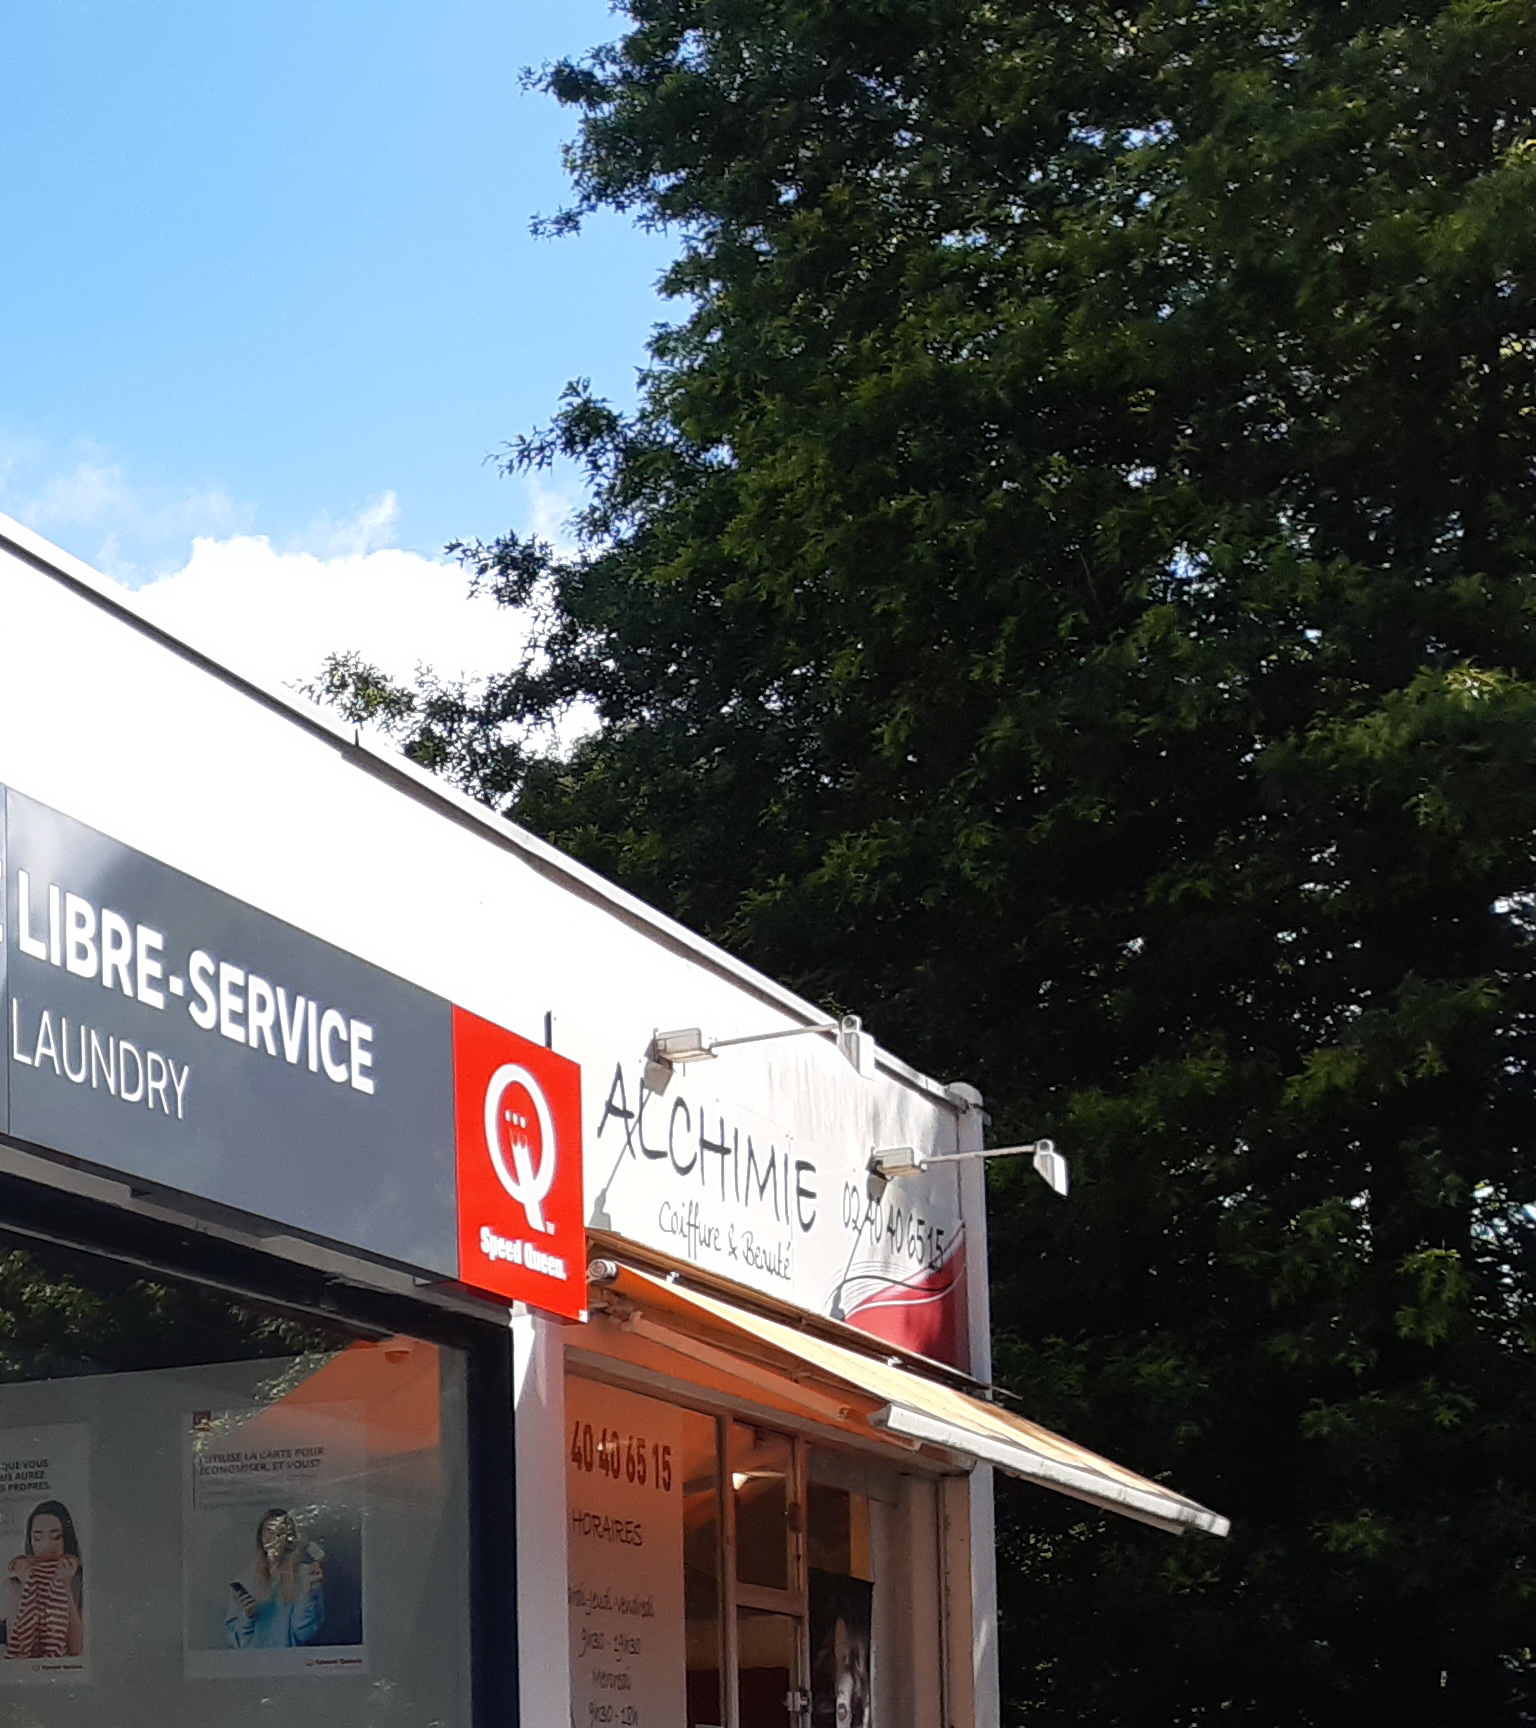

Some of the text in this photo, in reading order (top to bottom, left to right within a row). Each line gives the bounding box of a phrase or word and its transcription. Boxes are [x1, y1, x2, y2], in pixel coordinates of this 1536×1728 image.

[17, 868, 375, 1095] LIBRE-SERVICE
[12, 997, 190, 1120] LAUNDRY
[596, 1061, 817, 1234] ALCHIMIE
[480, 1225, 566, 1281] Speed Queen
[658, 1199, 722, 1261] Coiffure
[741, 1231, 792, 1281] Beauté
[887, 1204, 903, 1255] 40
[907, 1213, 925, 1264] 65
[23, 1459, 49, 1469] VOUS
[244, 1451, 257, 1461] LA
[260, 1449, 292, 1460] CARTE
[295, 1447, 325, 1457] POUR
[571, 1420, 594, 1472] 40
[626, 1435, 647, 1486] 65
[652, 1443, 672, 1492] 15
[572, 1509, 643, 1547] HORAIRES
